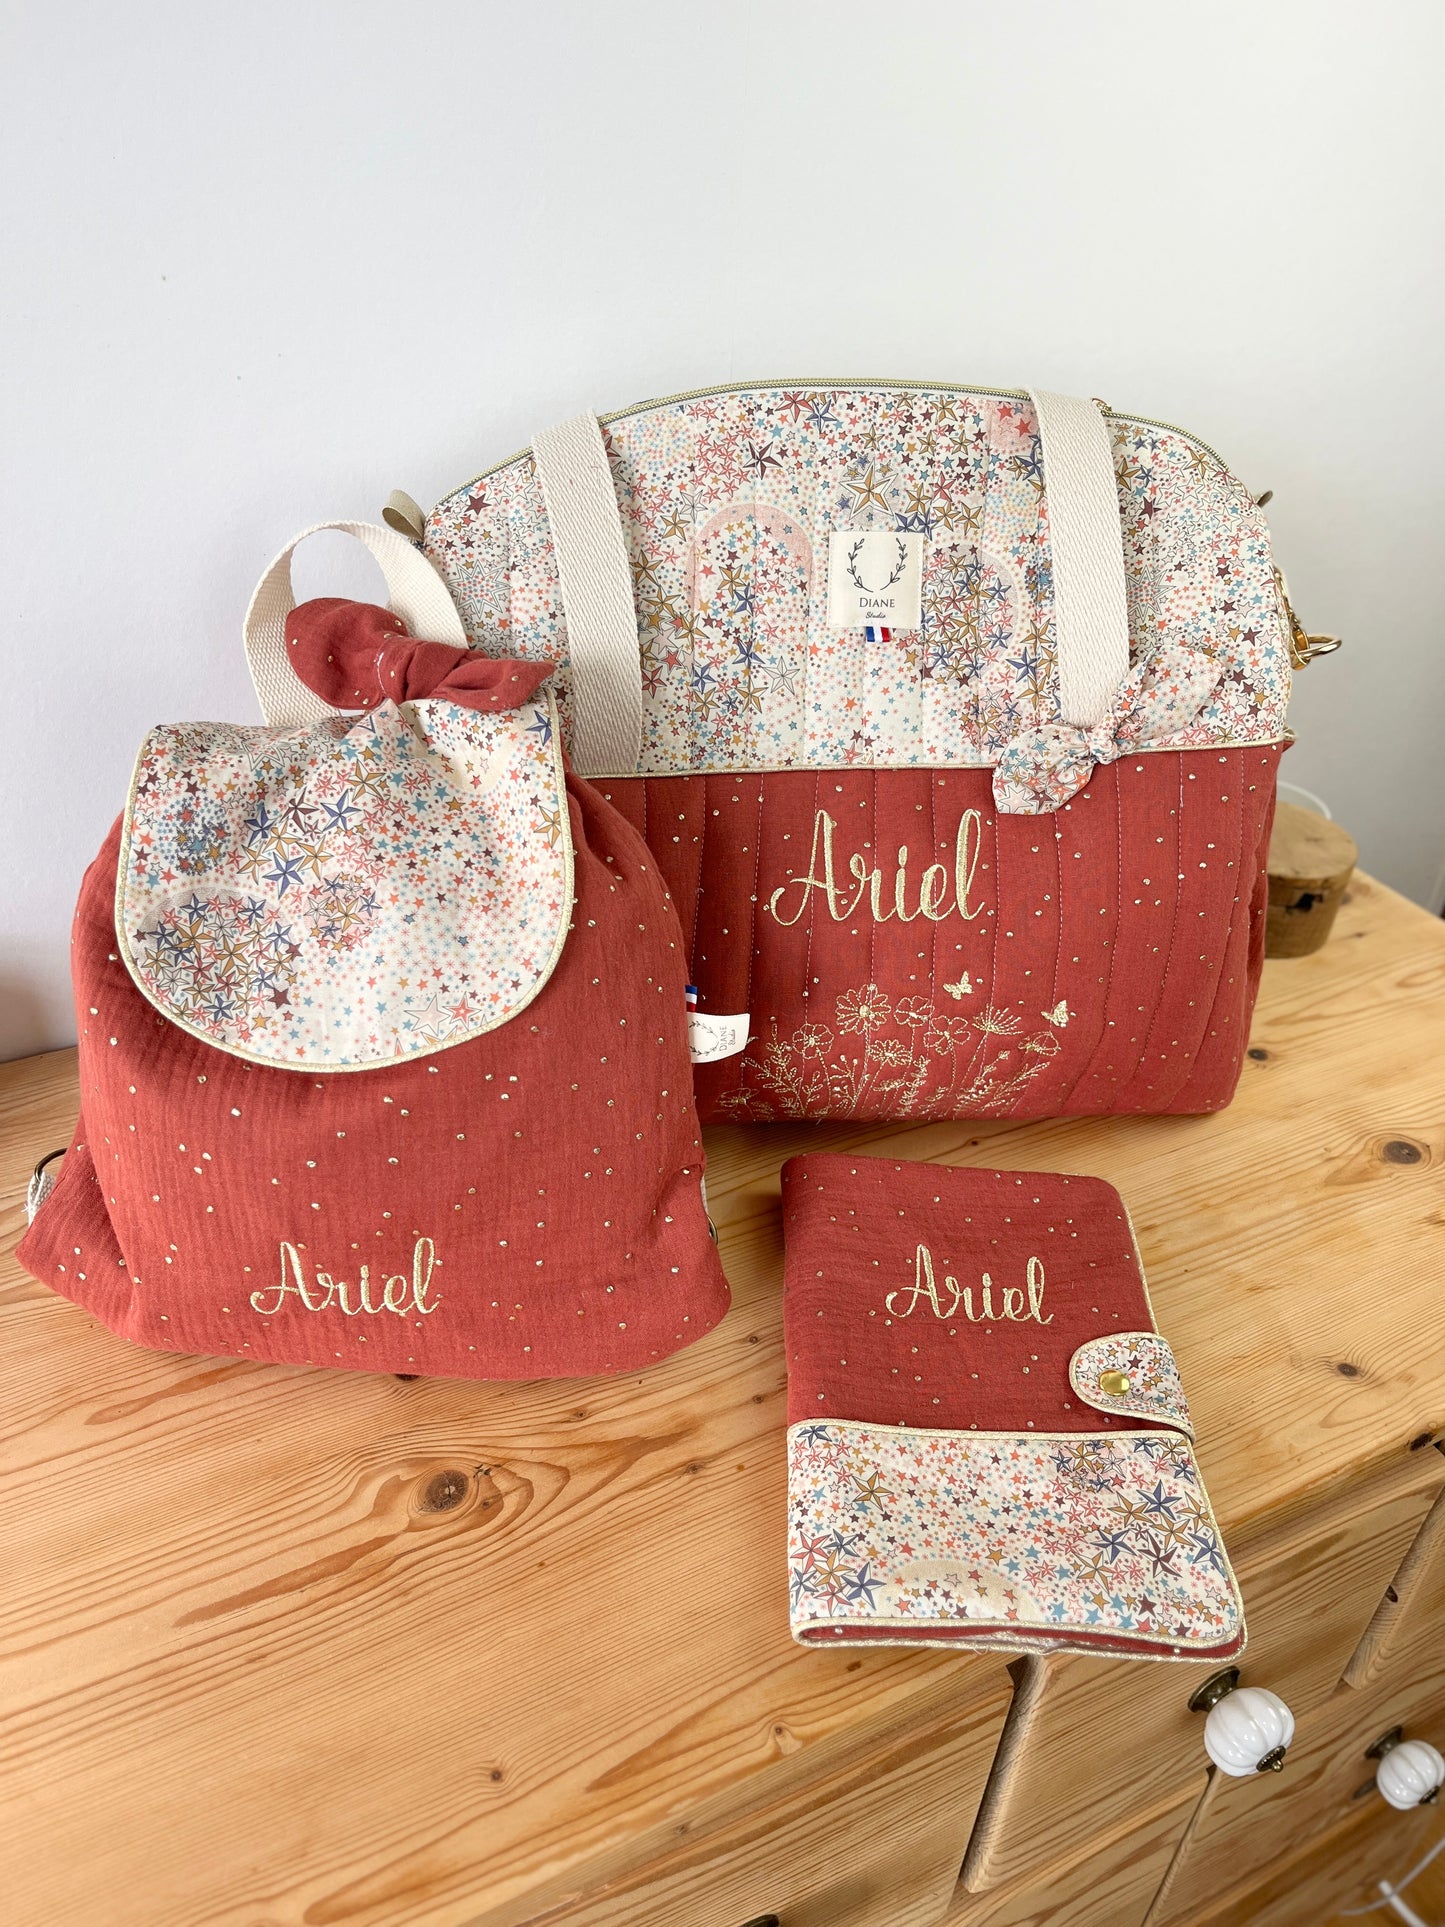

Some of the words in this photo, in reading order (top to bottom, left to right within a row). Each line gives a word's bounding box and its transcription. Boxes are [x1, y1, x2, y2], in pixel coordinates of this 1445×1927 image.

[859, 597, 895, 608] DIANE
[865, 611, 886, 619] Studio
[770, 808, 986, 926] Ariel
[719, 1025, 728, 1052] DIANE
[249, 1237, 440, 1316] Ariel
[885, 1243, 1054, 1325] Ariel
